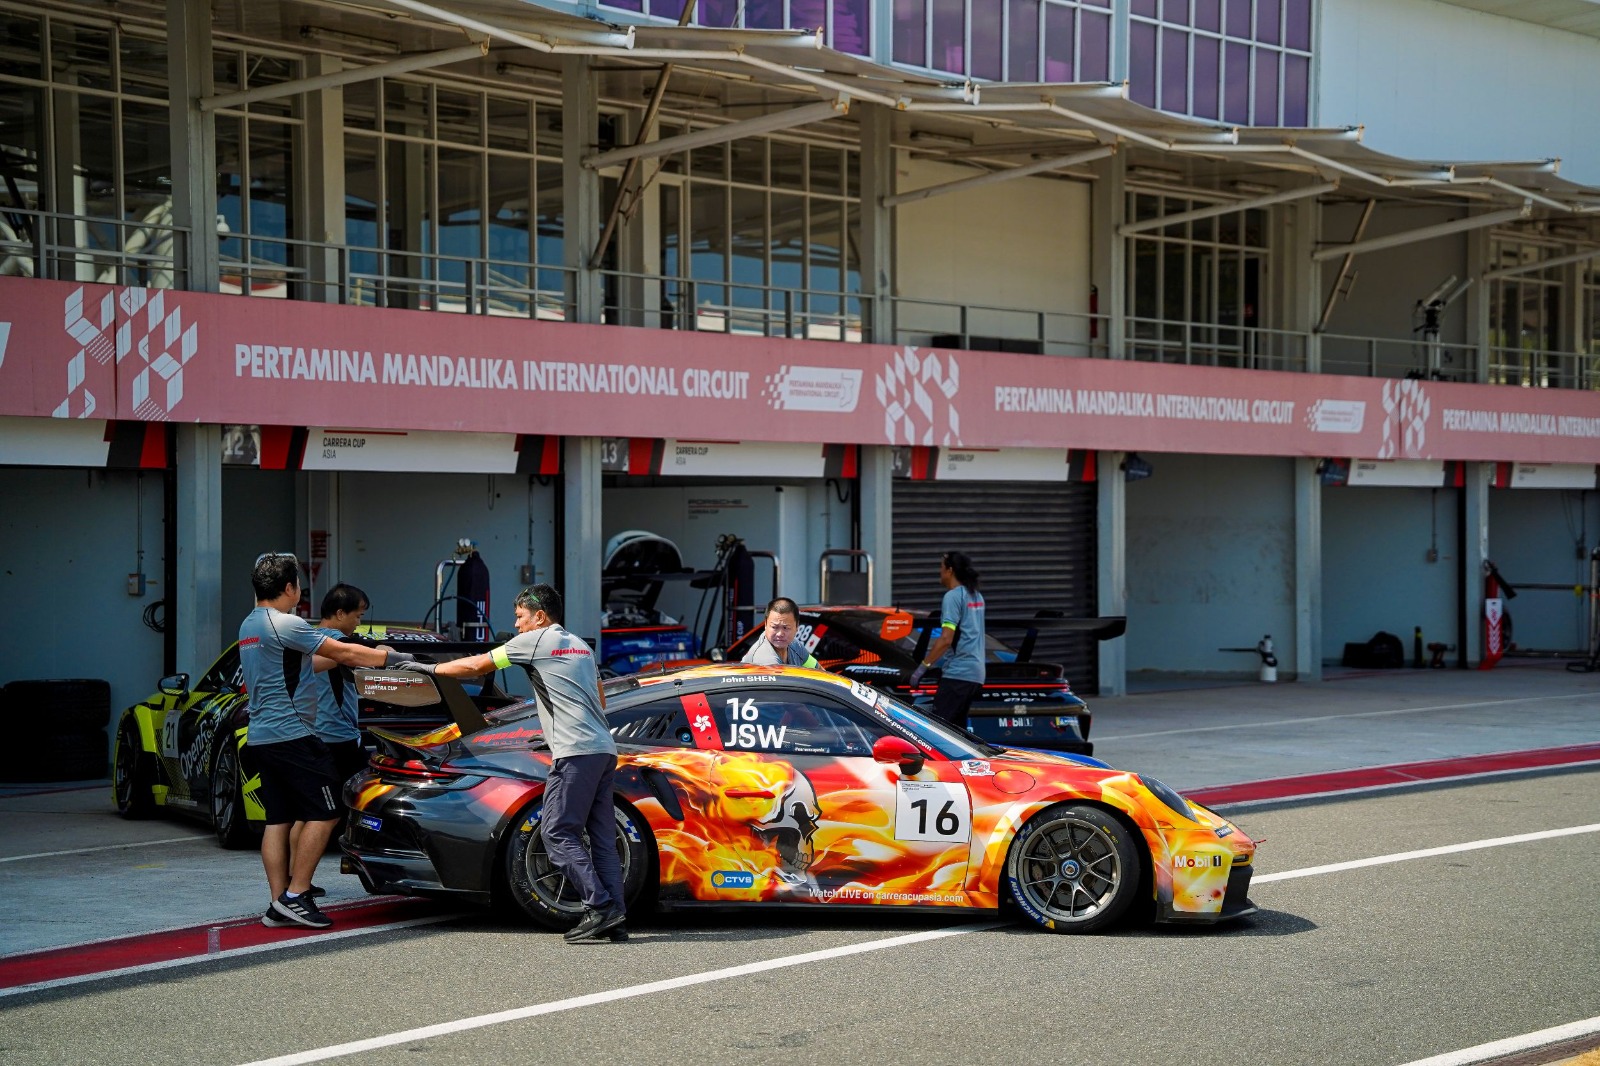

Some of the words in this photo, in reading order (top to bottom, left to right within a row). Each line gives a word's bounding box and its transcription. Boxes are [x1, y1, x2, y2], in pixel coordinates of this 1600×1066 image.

[235, 344, 377, 383] PERTAMINA
[382, 353, 518, 390] MANDALIKA
[523, 361, 678, 396] INTERNATIONAL
[683, 368, 749, 399] CIRCUIT
[994, 386, 1073, 414] PERTAMINA
[1076, 389, 1153, 418] MANDALIKA
[1156, 394, 1250, 422] INTERNATIONAL
[1252, 399, 1295, 424] CIRCUIT
[1443, 409, 1499, 432] PERTAMINA
[1500, 412, 1558, 436] MANDALIKA
[223, 431, 244, 456] 12
[322, 449, 337, 459] ASIA
[323, 437, 351, 448] CARRERA
[352, 438, 366, 448] CUP
[602, 442, 618, 464] 13
[364, 675, 423, 684] PORSCHE
[721, 676, 745, 684] John
[726, 697, 759, 721] 16
[874, 709, 933, 752] www.porsche.com
[998, 717, 1024, 727] Mobil
[165, 720, 176, 750] 21
[724, 723, 787, 749] JSW
[910, 798, 960, 836] 16
[1174, 855, 1211, 868] Mobil
[1213, 855, 1222, 867] 1
[808, 888, 838, 899] Watch
[840, 888, 862, 899] LIVE
[862, 891, 875, 900] on
[876, 892, 964, 903] carreracupasia.com
